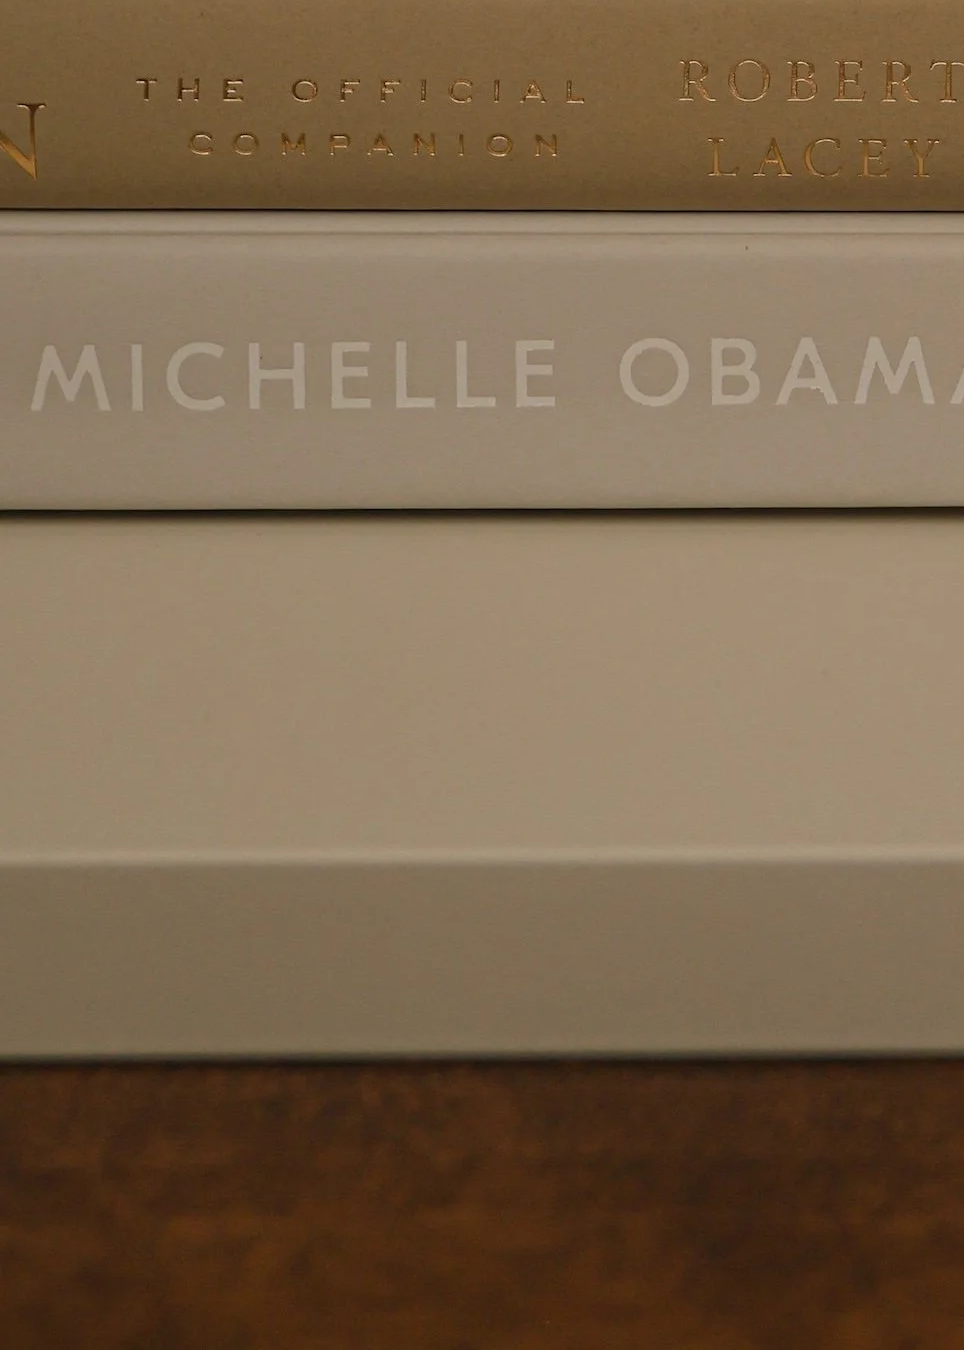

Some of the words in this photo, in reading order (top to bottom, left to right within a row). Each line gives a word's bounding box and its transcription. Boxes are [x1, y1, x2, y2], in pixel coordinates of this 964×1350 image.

[136, 78, 244, 102] THE
[291, 79, 585, 104] OFFICIAL
[190, 131, 557, 157] COMPANION
[707, 137, 940, 178] LACEY
[31, 338, 556, 411] MICHELLE
